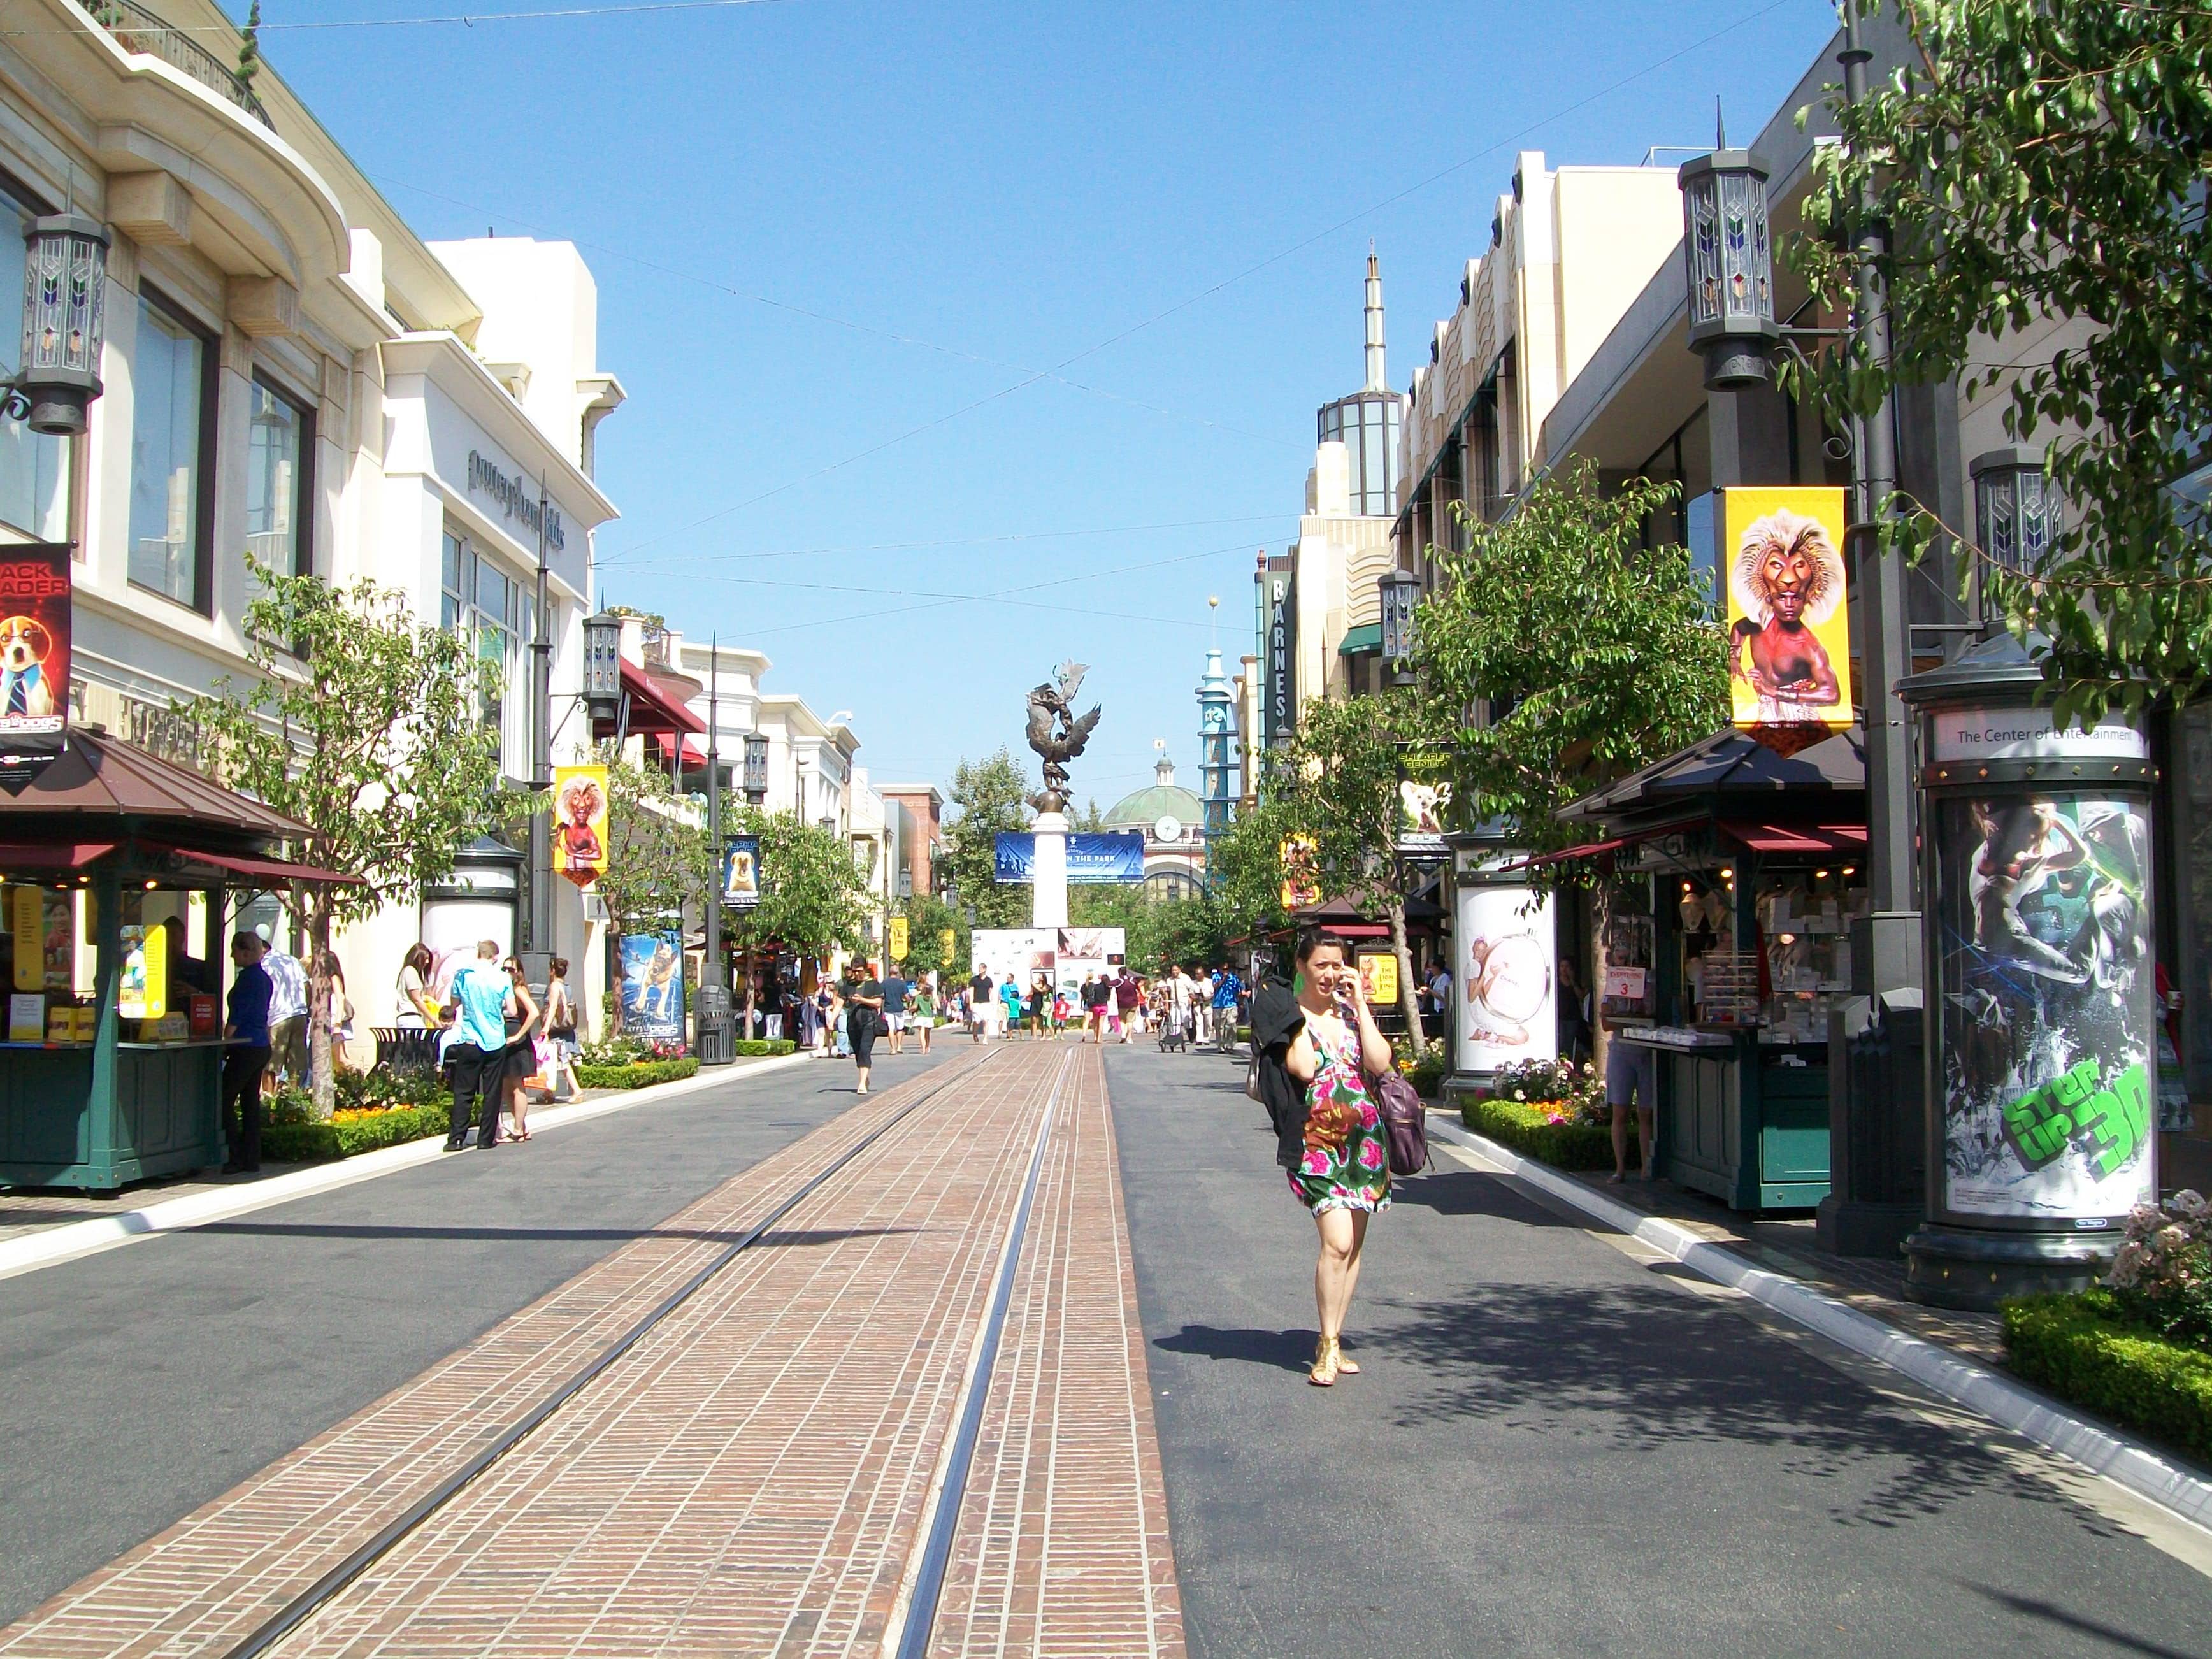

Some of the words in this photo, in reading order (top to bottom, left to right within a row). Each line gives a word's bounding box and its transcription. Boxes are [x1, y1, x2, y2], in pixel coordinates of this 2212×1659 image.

[0, 564, 51, 579] ACK
[0, 579, 66, 594] ADER
[1272, 580, 1286, 717] BARNES
[1958, 731, 1981, 743] The
[1984, 729, 2030, 742] Center
[2034, 726, 2050, 740] of
[2053, 728, 2133, 740] Enteainment
